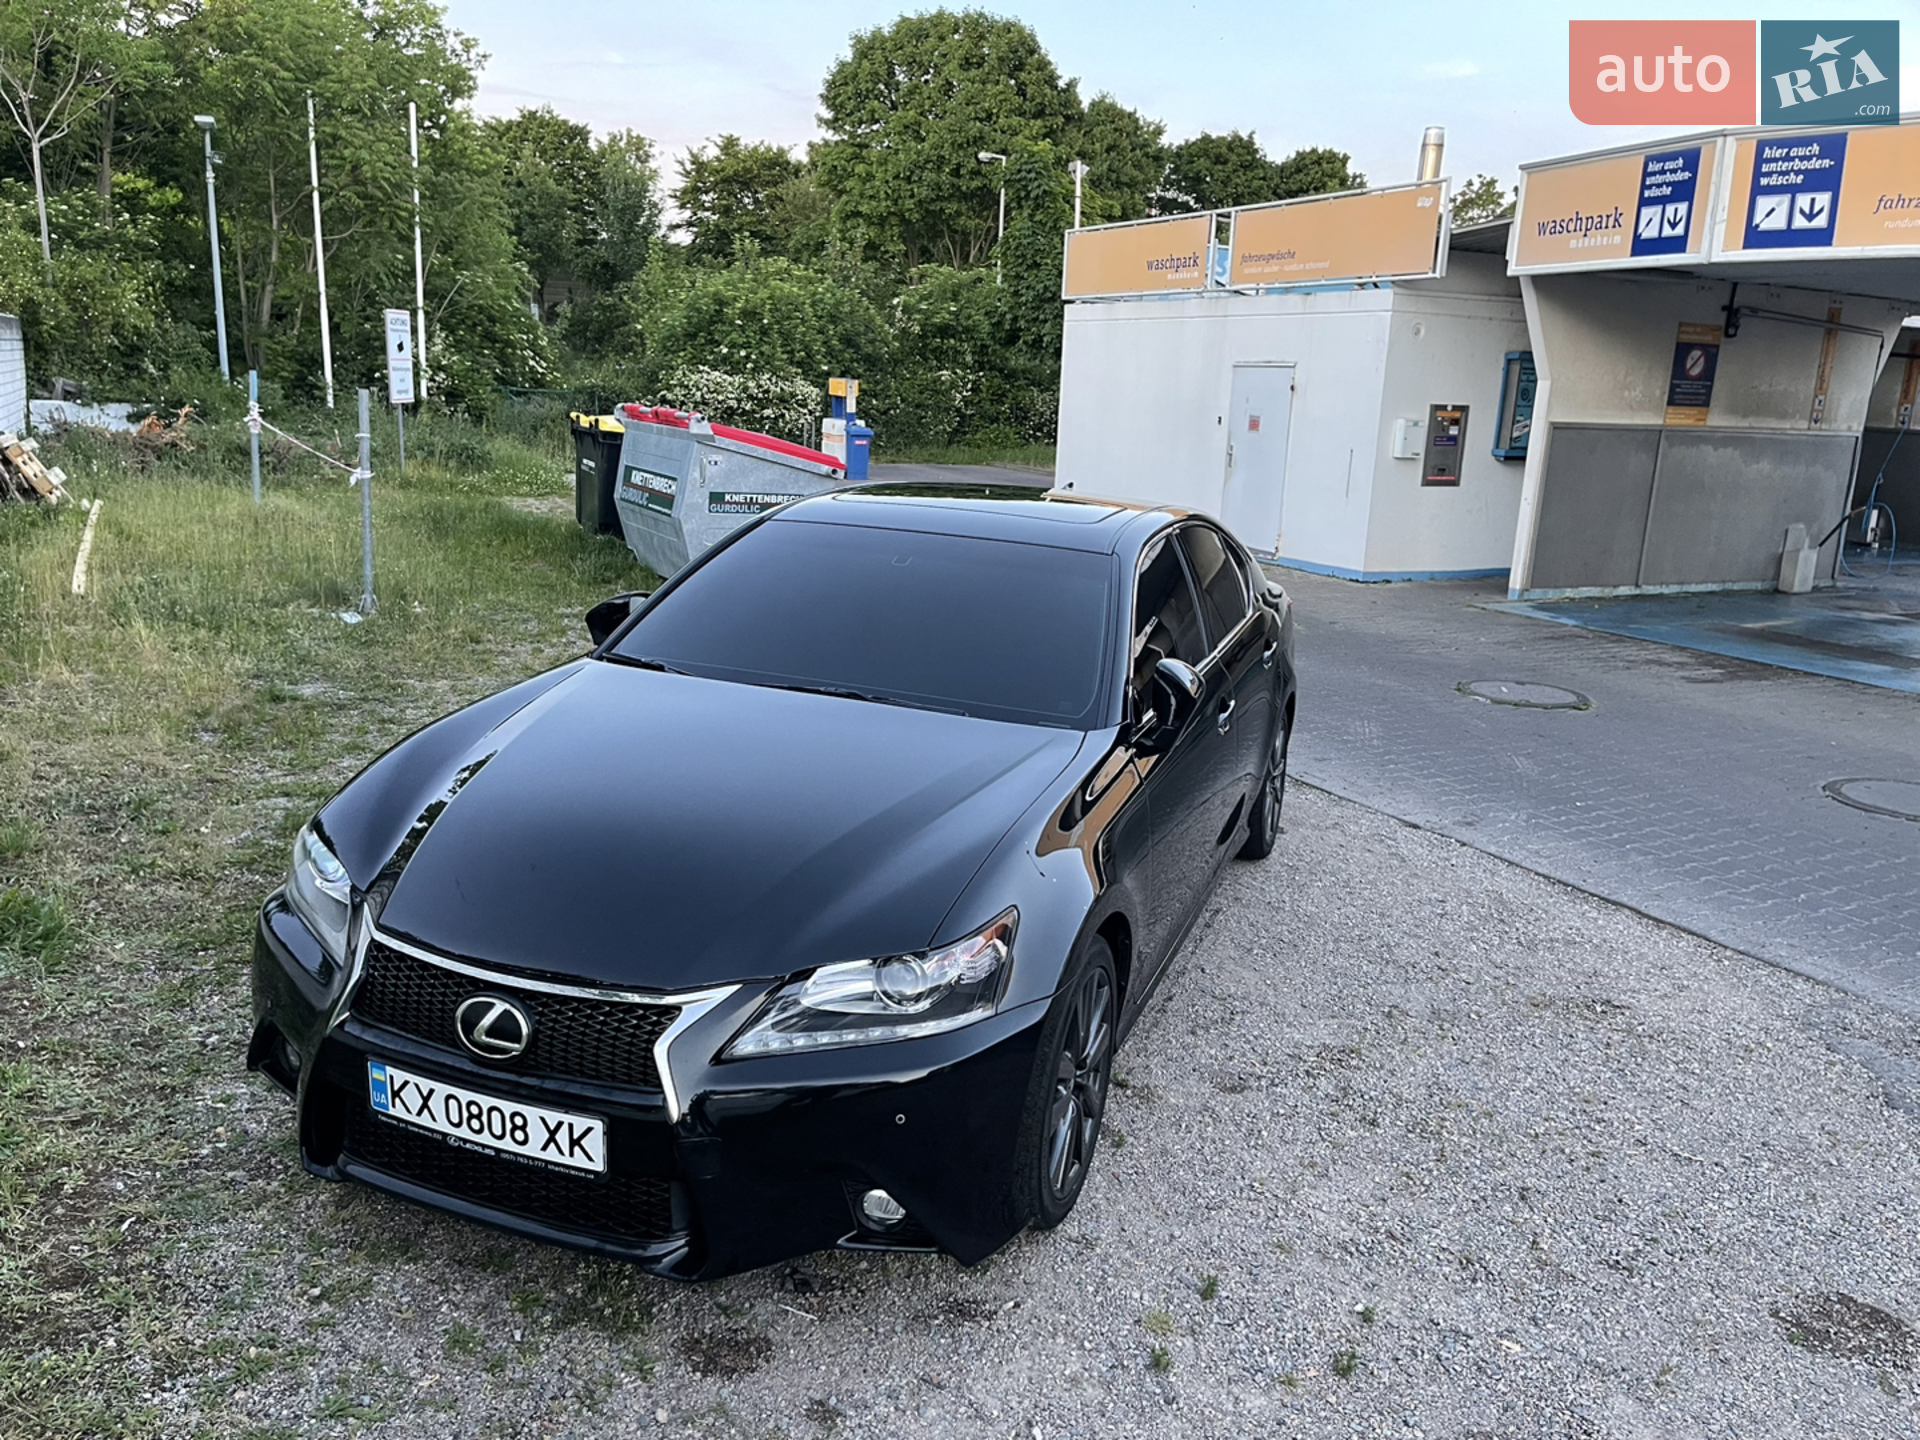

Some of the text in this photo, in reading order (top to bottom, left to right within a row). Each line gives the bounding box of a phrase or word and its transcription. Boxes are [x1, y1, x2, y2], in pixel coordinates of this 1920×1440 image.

[1763, 142, 1820, 159] hier auch
[1647, 157, 1684, 172] hier auch
[1761, 157, 1835, 172] unterboden-
[1645, 169, 1692, 185] unterboden-
[1759, 172, 1805, 186] wäsche
[1643, 184, 1672, 198] wäsche
[1537, 206, 1624, 237] waschpark
[1569, 233, 1622, 248] mannheim
[1146, 252, 1200, 273] waschpark
[710, 503, 761, 513] GURDULIC
[373, 1091, 387, 1105] UA
[388, 1074, 596, 1163] KX 0808 XK
[459, 1141, 496, 1156] LEXUS
